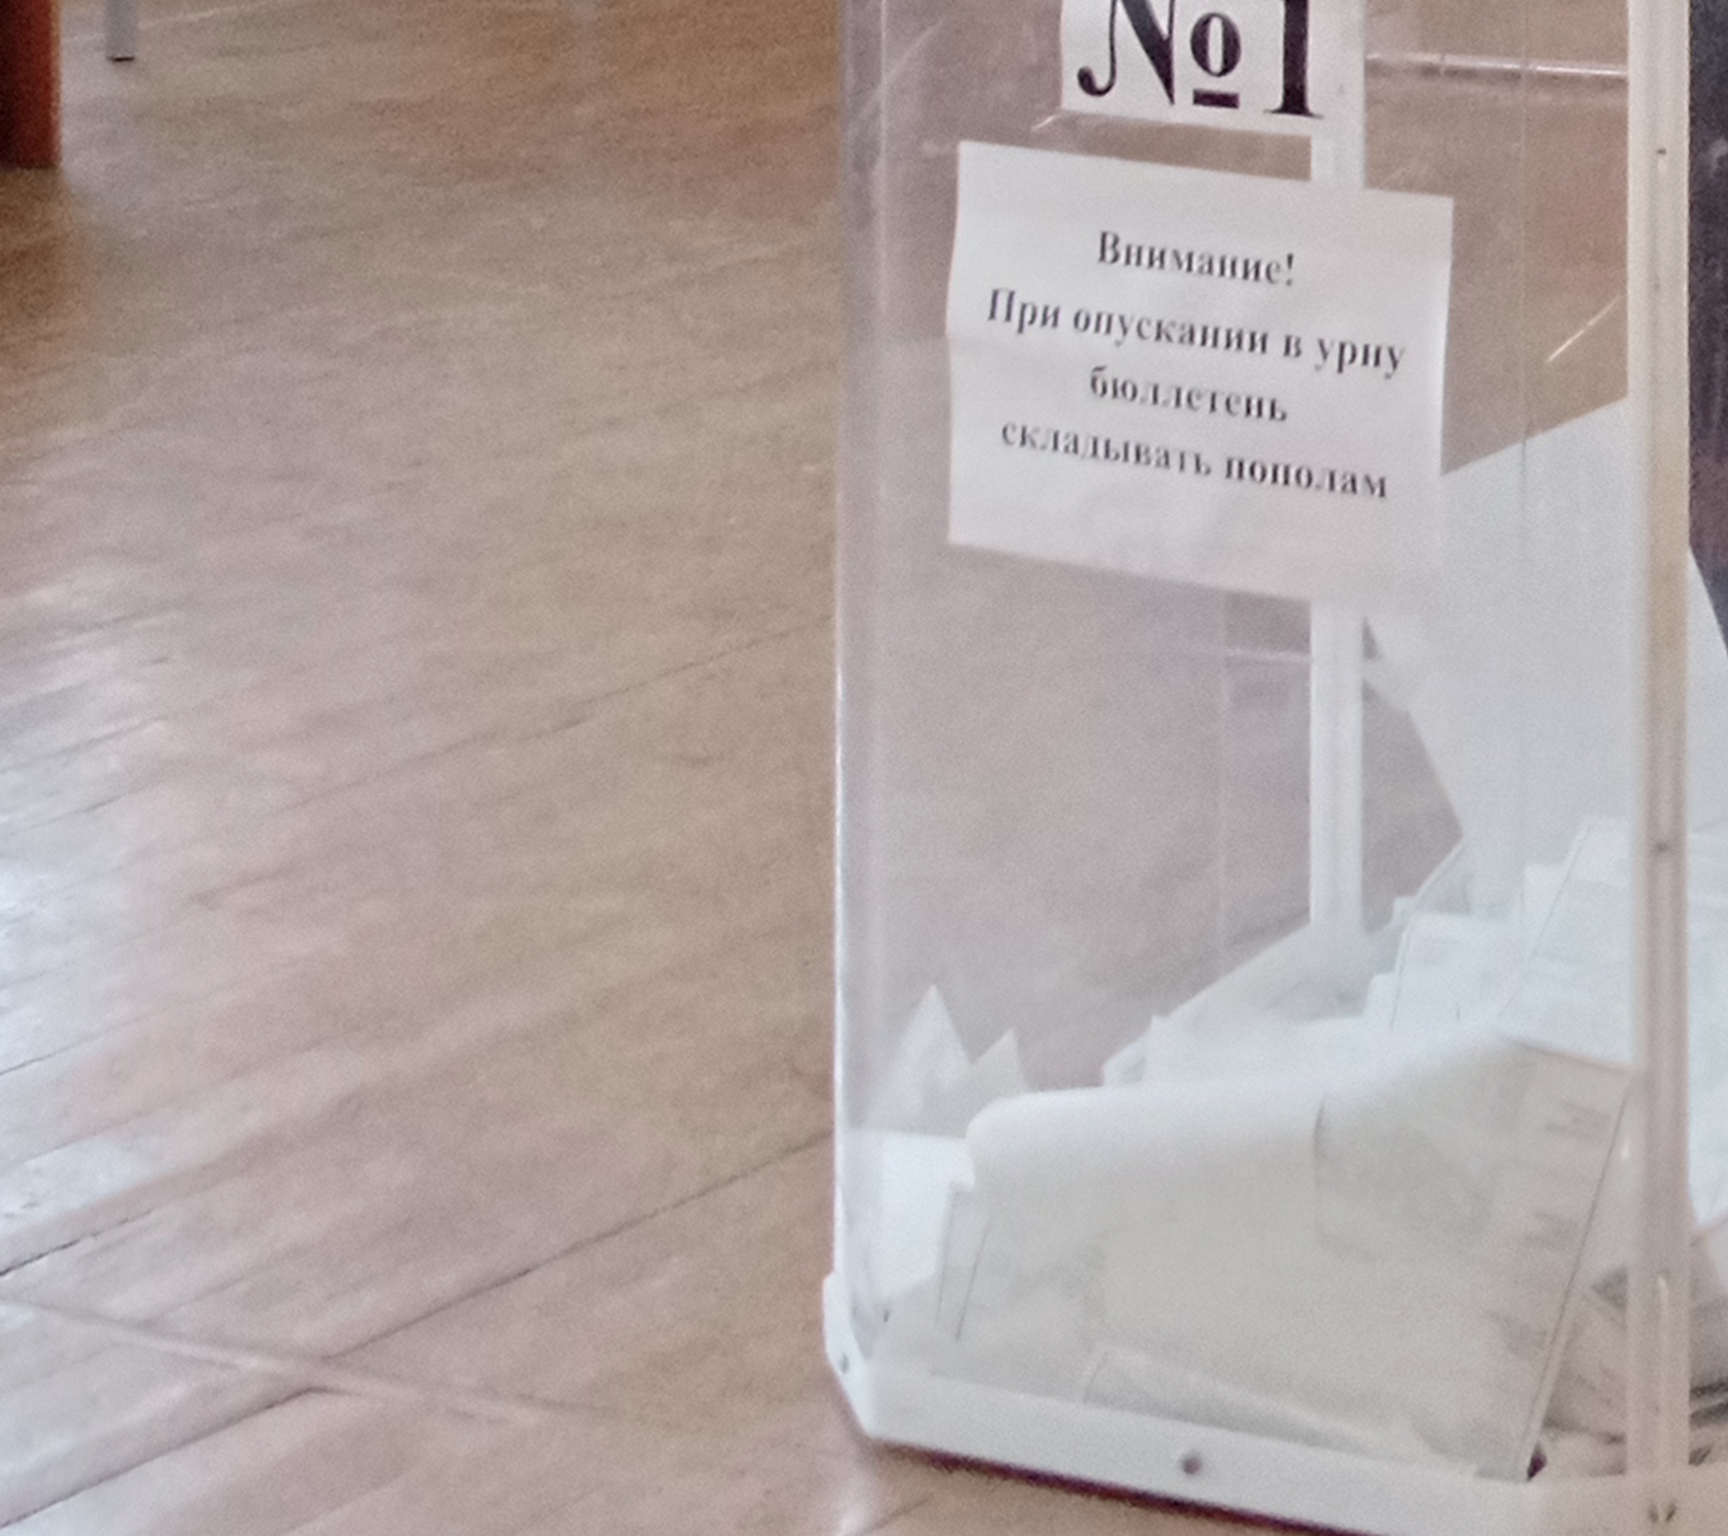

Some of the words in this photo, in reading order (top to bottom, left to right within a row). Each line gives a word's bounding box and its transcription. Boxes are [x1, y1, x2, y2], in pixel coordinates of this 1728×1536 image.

[1097, 230, 1296, 287] Внимание!
[987, 288, 1061, 334] При
[1072, 304, 1268, 355] опускании
[1282, 333, 1303, 359] в
[1313, 335, 1407, 380] урну
[1089, 365, 1288, 423] бюллетень
[1001, 420, 1212, 478] складывать
[1223, 456, 1389, 499] пополам
